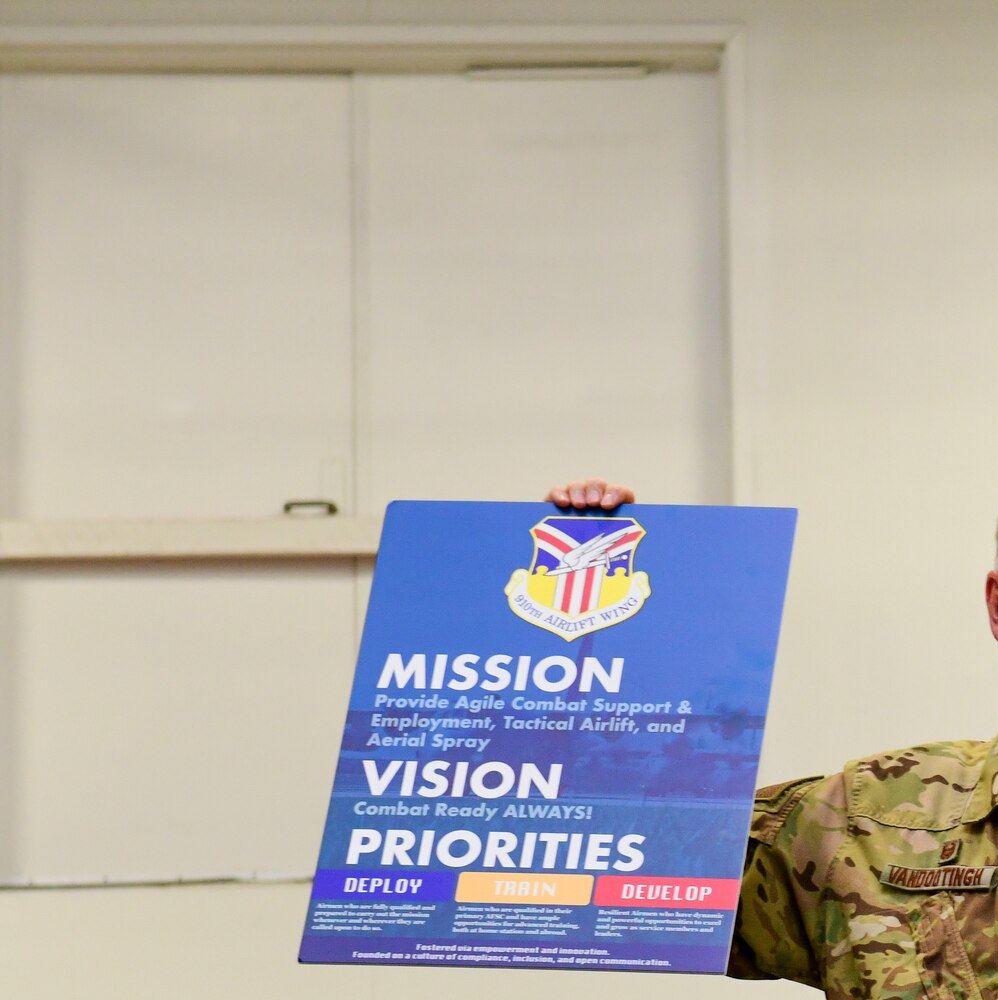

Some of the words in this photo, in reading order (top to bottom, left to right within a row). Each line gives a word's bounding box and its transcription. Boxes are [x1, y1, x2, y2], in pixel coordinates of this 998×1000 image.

[514, 594, 543, 619] 910TH
[544, 614, 596, 633] AIRLIFT
[600, 597, 638, 621] WING
[376, 653, 624, 693] MISSION
[374, 694, 449, 709] Provide
[455, 695, 505, 713] Agile
[511, 696, 587, 711] Combat
[592, 698, 672, 716] Support
[676, 700, 693, 714] &
[371, 713, 497, 732] Employment,
[503, 715, 575, 731] Tactical
[579, 717, 640, 734] Airlift,
[647, 719, 686, 734] and
[366, 733, 427, 747] Aerial
[431, 733, 490, 752] Spray
[362, 760, 563, 800] VISION
[353, 801, 430, 816] Combat
[435, 802, 499, 821] Ready
[502, 804, 593, 820] ALWAYS!
[346, 829, 647, 872] PRIORITIES
[343, 877, 423, 894] DEPLOY
[494, 880, 557, 896] TRAIN
[621, 884, 713, 901] DEVELOP
[352, 951, 391, 959] Founded
[457, 954, 511, 962] compliance,
[513, 955, 555, 963] inclusion,
[557, 956, 575, 964] and
[599, 958, 671, 966] communication.
[416, 943, 456, 951] Fostered
[473, 945, 539, 953] empowerment
[559, 947, 610, 955] innovation.
